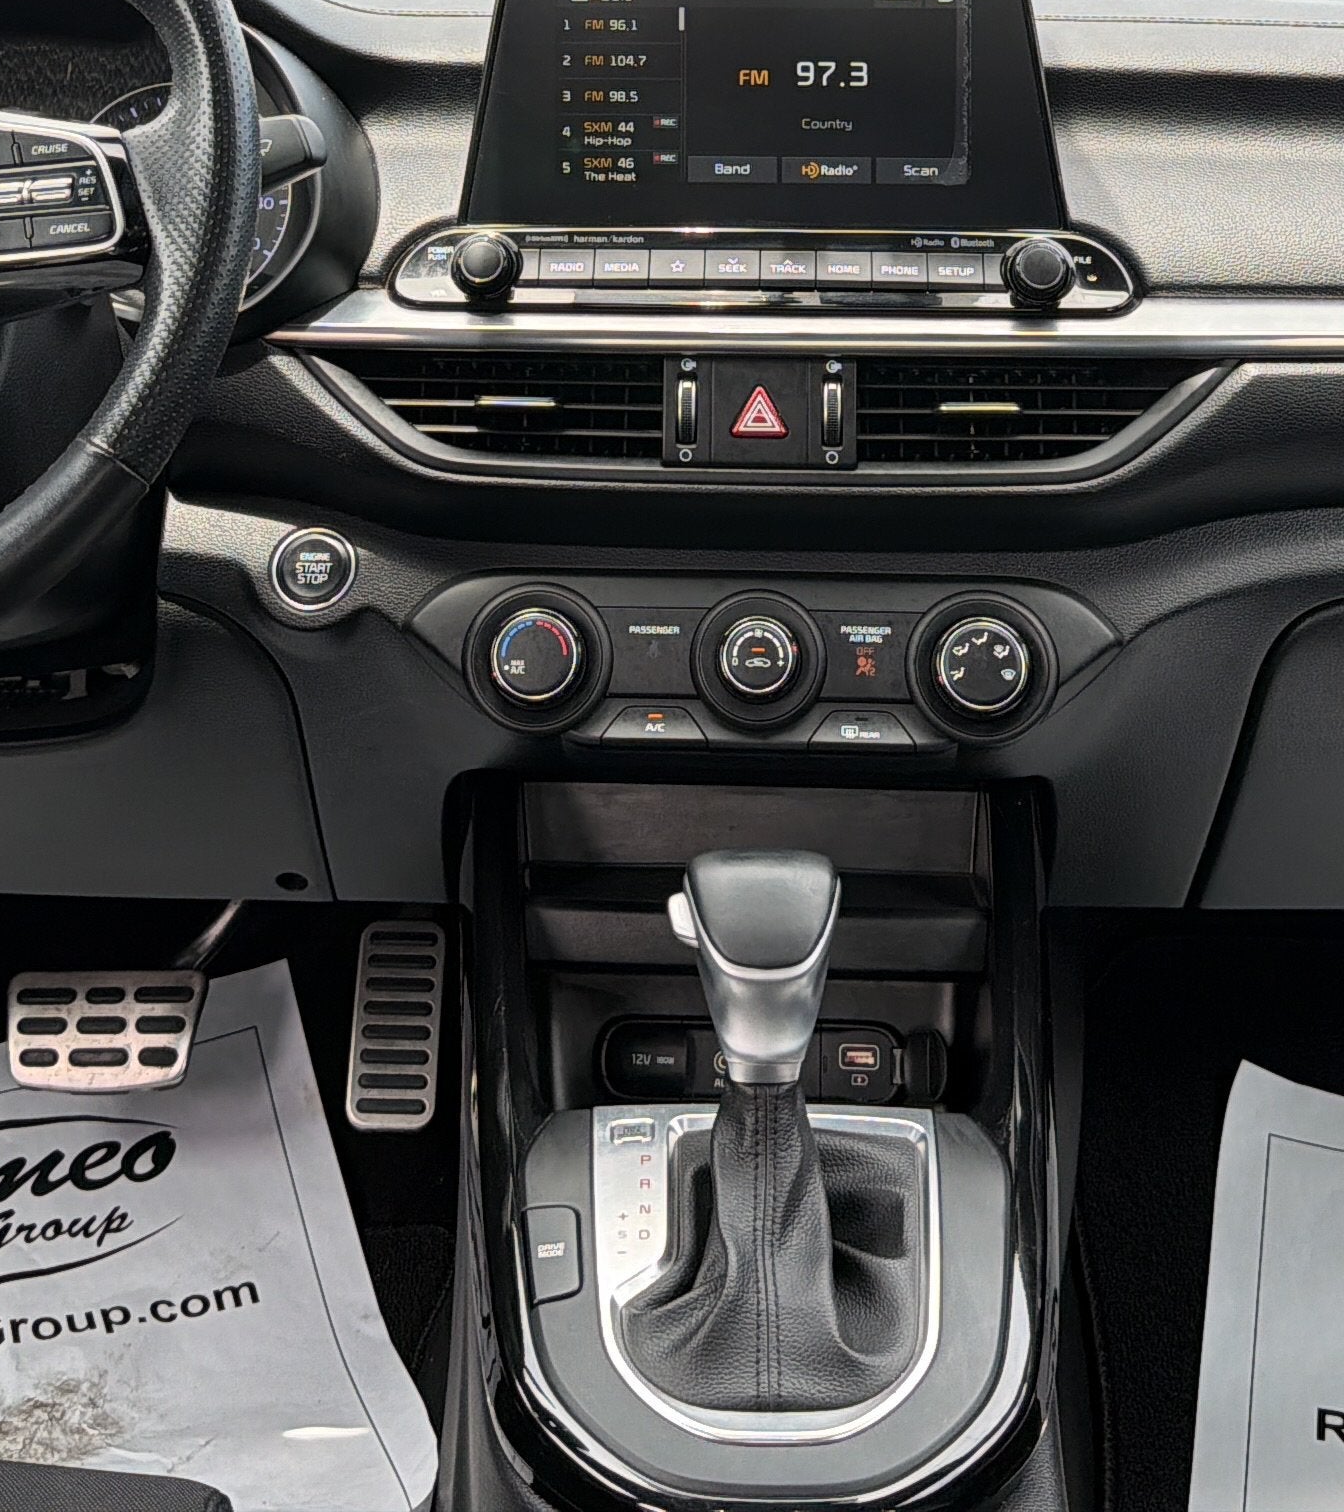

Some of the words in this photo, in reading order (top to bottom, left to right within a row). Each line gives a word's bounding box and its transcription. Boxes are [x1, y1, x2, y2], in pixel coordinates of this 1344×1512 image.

[563, 19, 571, 31] 1
[584, 19, 604, 30] FM
[609, 19, 638, 31] 96.1
[562, 55, 572, 67] 2
[584, 55, 604, 66] FM
[610, 55, 647, 67] 104.7
[737, 69, 769, 86] FM
[796, 61, 869, 88] 97.3
[562, 90, 571, 102] 3
[584, 90, 604, 102] FM
[609, 90, 639, 102] 98.5
[562, 126, 571, 137] 4
[583, 121, 612, 133] SXM
[617, 121, 635, 133] 44
[801, 118, 853, 131] Country
[584, 135, 632, 147] Hip-Hop
[31, 143, 69, 156] CRUISE
[562, 161, 571, 173] 5
[583, 157, 612, 169] SXM
[617, 157, 635, 169] 46
[714, 163, 751, 175] Band
[903, 165, 939, 176] Scan
[78, 176, 97, 185] RES
[584, 171, 606, 182] The
[608, 171, 637, 182] Heat
[49, 222, 91, 235] CANCEL
[550, 262, 584, 272] RADIO
[604, 262, 639, 272] MEDIA
[718, 263, 747, 273] SEEK
[770, 264, 806, 274] TRACK
[827, 264, 860, 275] HOME
[880, 265, 919, 275] PHONE
[938, 266, 975, 276] SETUP
[295, 562, 333, 573] START
[296, 573, 329, 584] STOP
[628, 625, 681, 635] PASSENGER
[840, 625, 892, 635] PASSENGER
[849, 635, 864, 643] AIR
[865, 635, 883, 644] BAG
[856, 646, 875, 656] OFF
[644, 722, 666, 733] A/C
[631, 1053, 652, 1065] 12V
[640, 1154, 652, 1166] P
[639, 1204, 652, 1215] N
[638, 1229, 651, 1241] D
[537, 1242, 565, 1251] DRIVE
[537, 1249, 564, 1258] MODE
